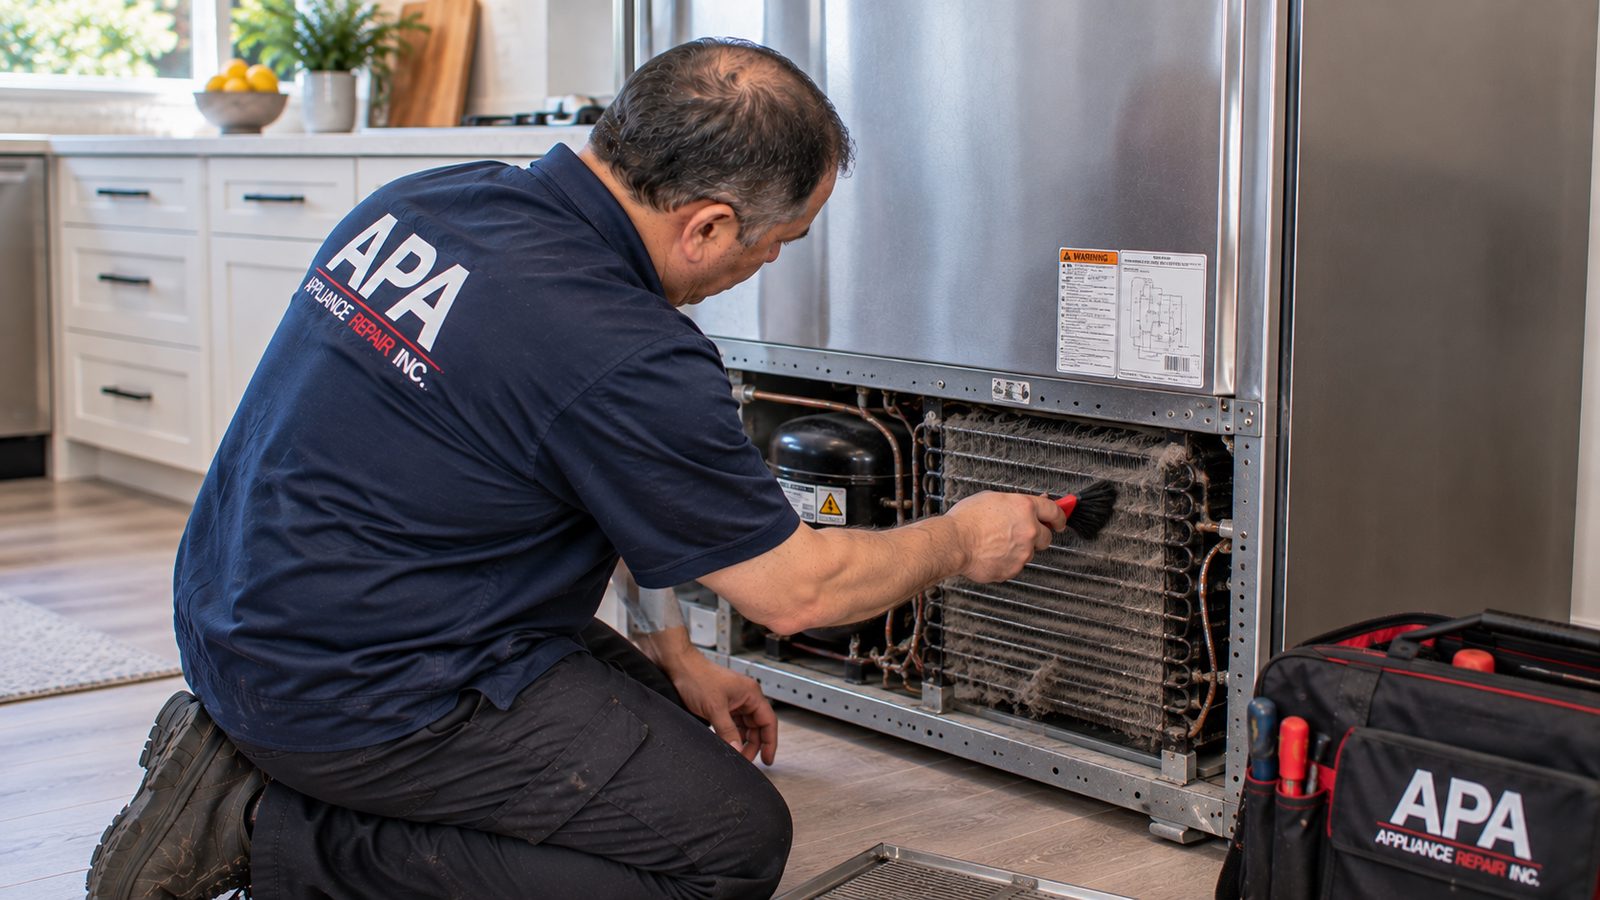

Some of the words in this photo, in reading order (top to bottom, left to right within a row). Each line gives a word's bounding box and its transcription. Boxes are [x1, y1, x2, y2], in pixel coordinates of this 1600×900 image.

[304, 275, 355, 321] APPLIANCE
[348, 312, 396, 357] REPAIR
[392, 347, 428, 389] INC.
[325, 212, 470, 353] APA
[1375, 828, 1454, 864] APPLIANCE
[1455, 850, 1507, 877] REPAIR
[1508, 864, 1540, 887] INC.
[1389, 768, 1532, 861] APA
